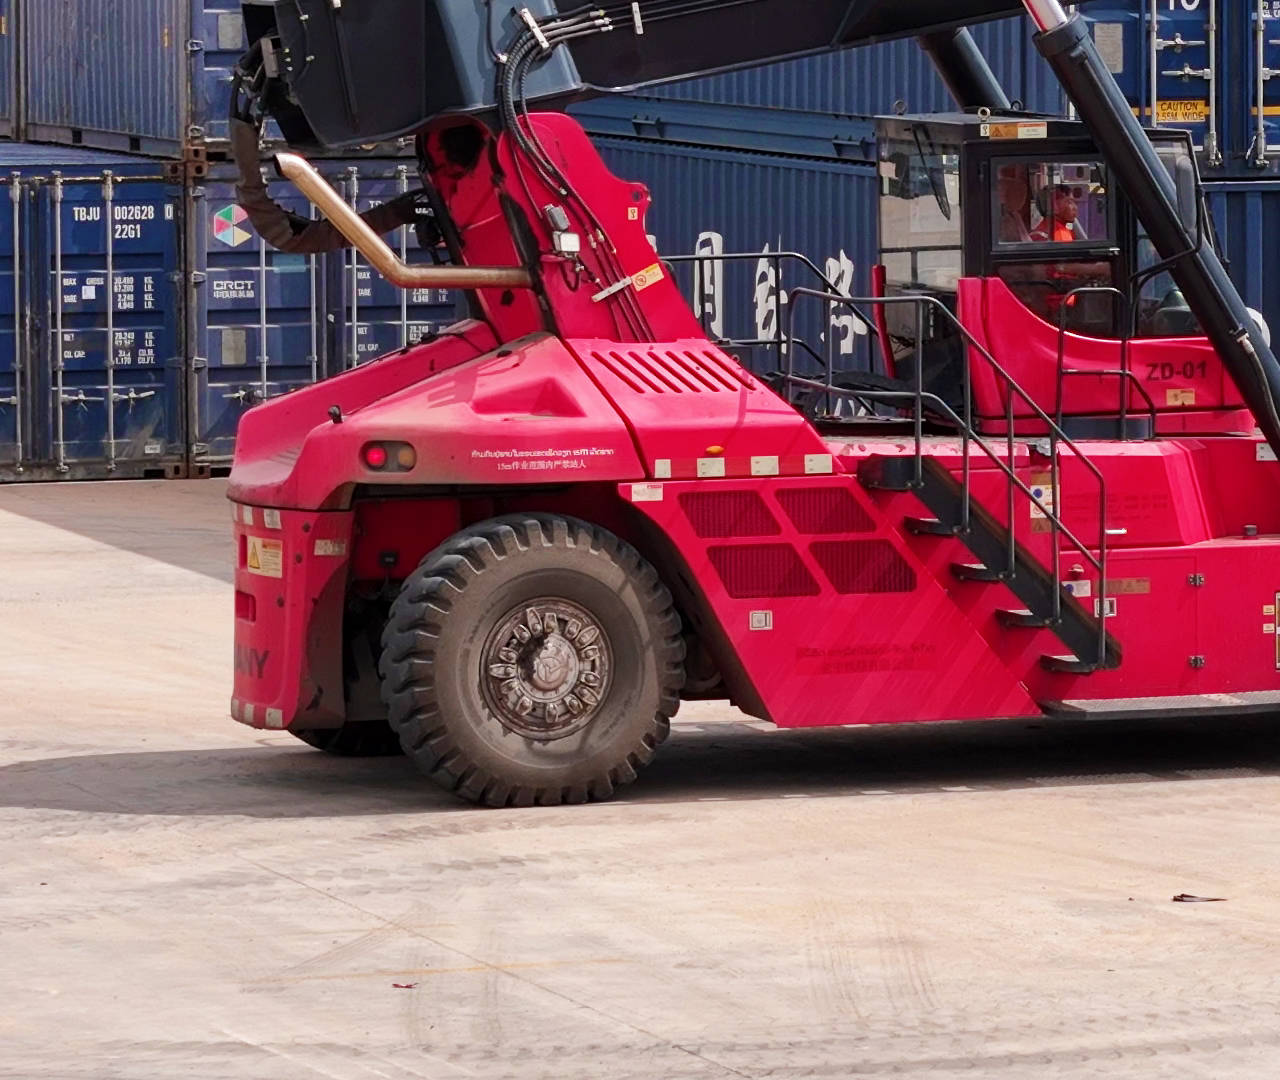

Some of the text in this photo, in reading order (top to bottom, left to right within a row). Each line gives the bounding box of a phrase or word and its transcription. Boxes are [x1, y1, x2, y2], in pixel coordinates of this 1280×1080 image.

[1160, 101, 1199, 111] CAUTION
[73, 206, 101, 222] TBJU
[114, 205, 155, 220] 002628
[114, 224, 141, 239] 22G1
[1146, 360, 1208, 381] ZD-01
